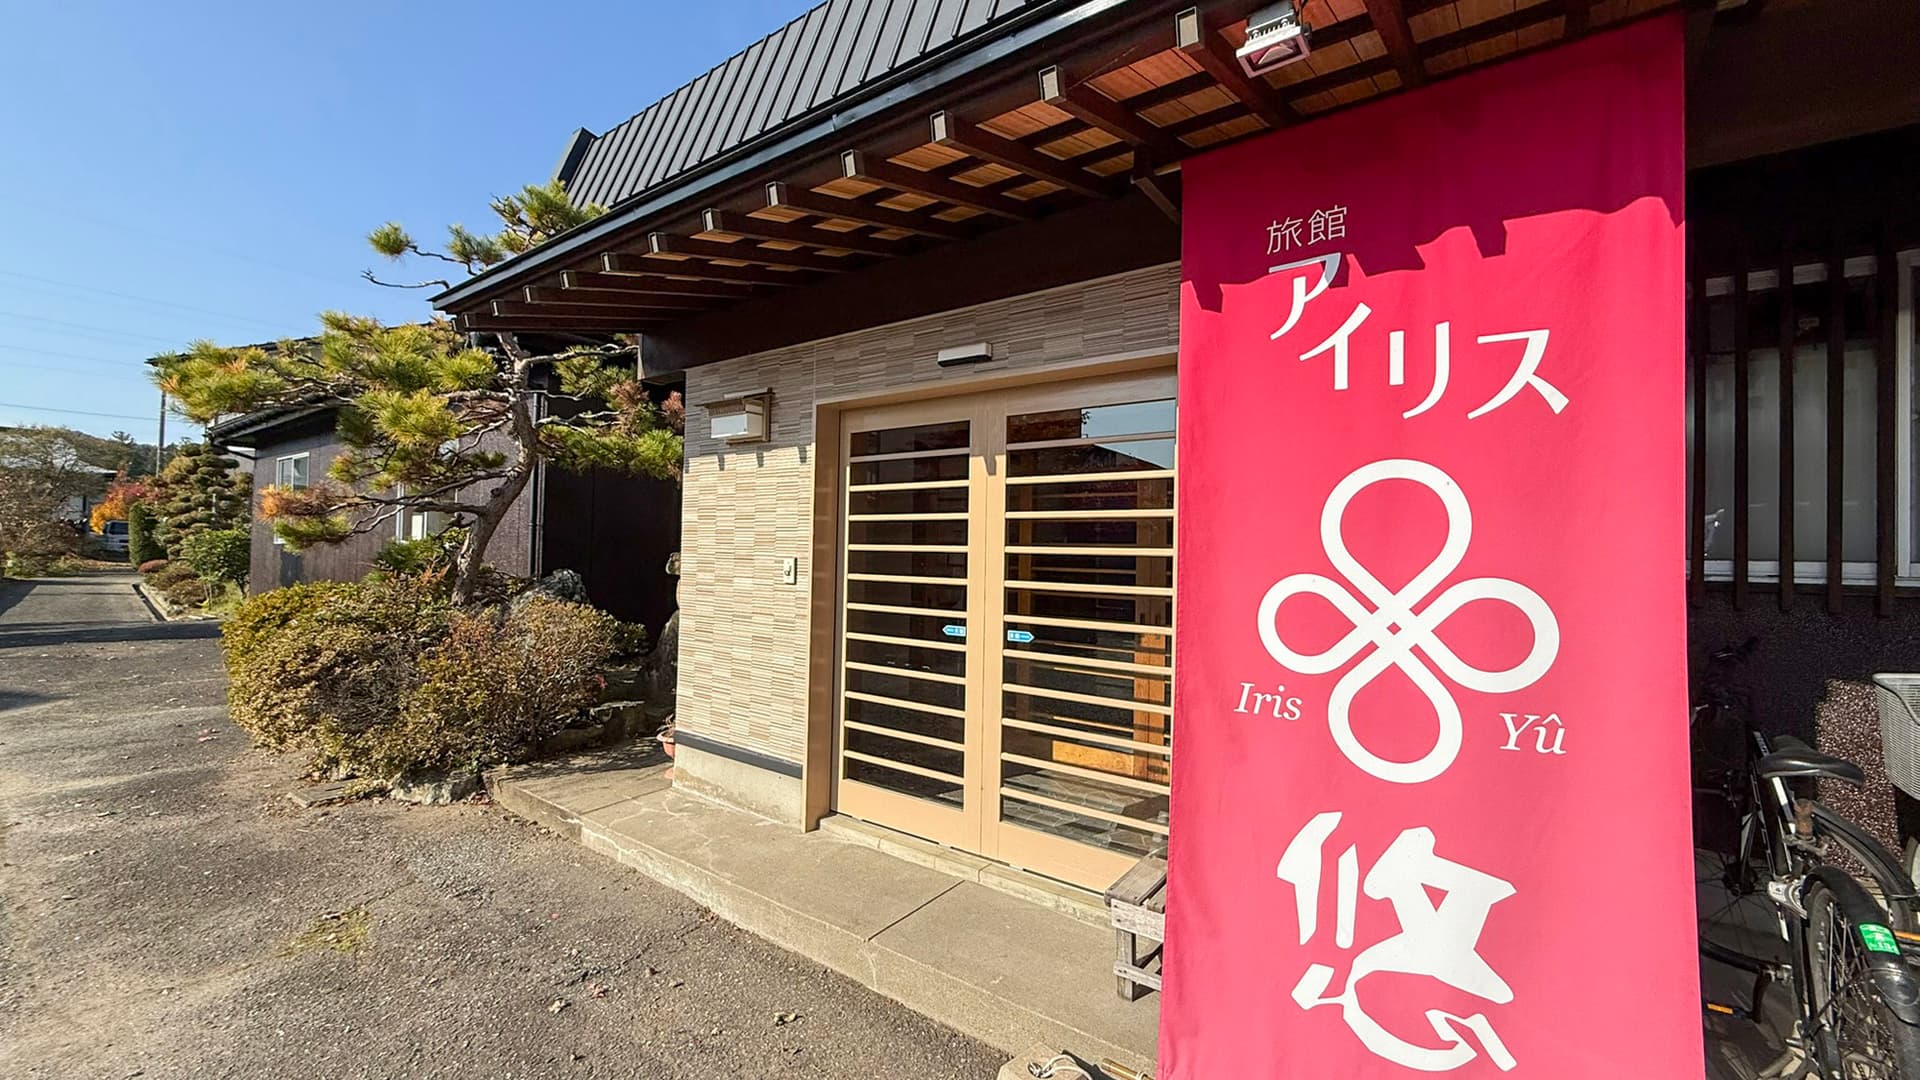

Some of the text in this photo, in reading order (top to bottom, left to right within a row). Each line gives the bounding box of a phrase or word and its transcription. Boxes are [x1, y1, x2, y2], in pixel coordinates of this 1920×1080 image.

[1266, 205, 1347, 253] 旅館
[1268, 252, 1570, 420] アイリス
[1234, 682, 1303, 721] Iris
[1499, 712, 1567, 755] Yû
